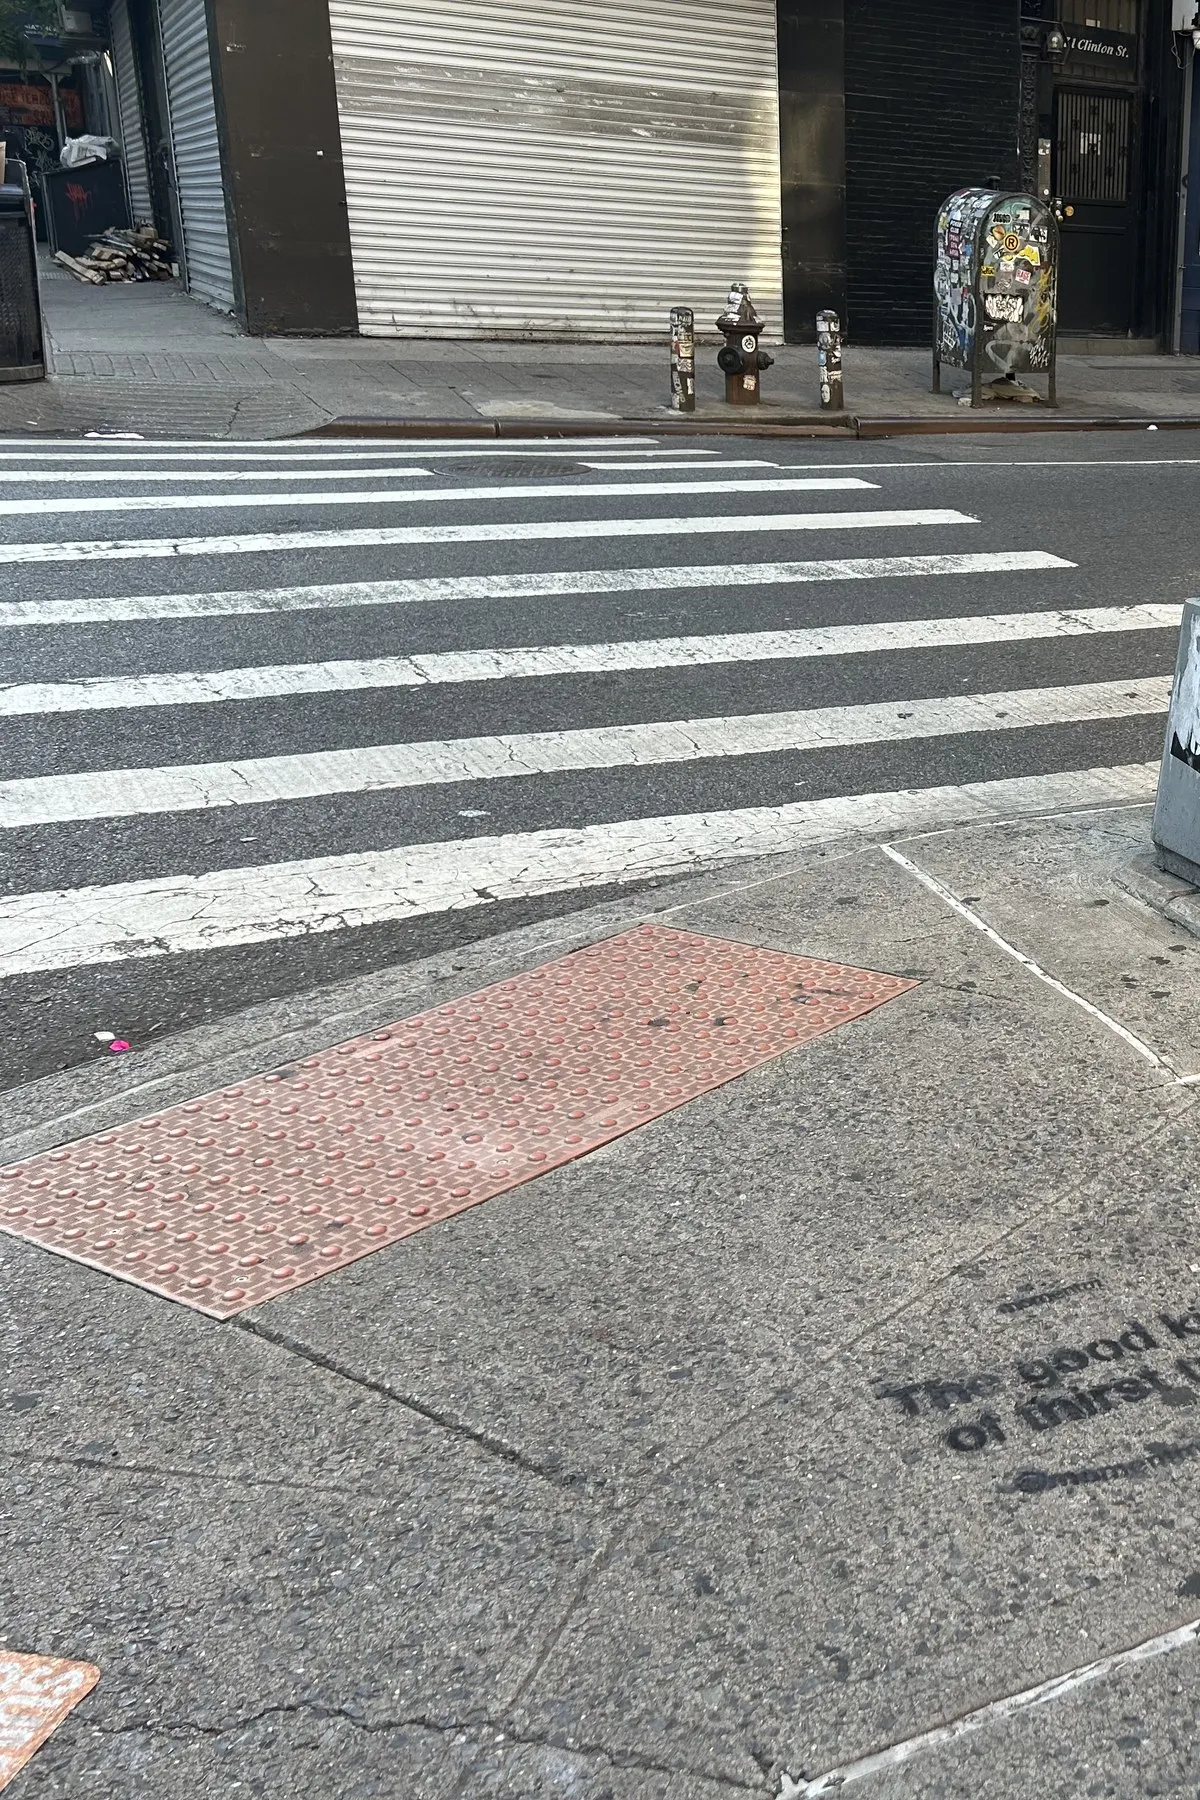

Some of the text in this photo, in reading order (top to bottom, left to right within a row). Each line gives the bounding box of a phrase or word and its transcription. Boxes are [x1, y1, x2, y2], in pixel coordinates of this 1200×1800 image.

[1077, 38, 1114, 55] Clinton
[1115, 45, 1129, 58] St.
[1017, 1320, 1159, 1389] good
[946, 1410, 1006, 1453] of
